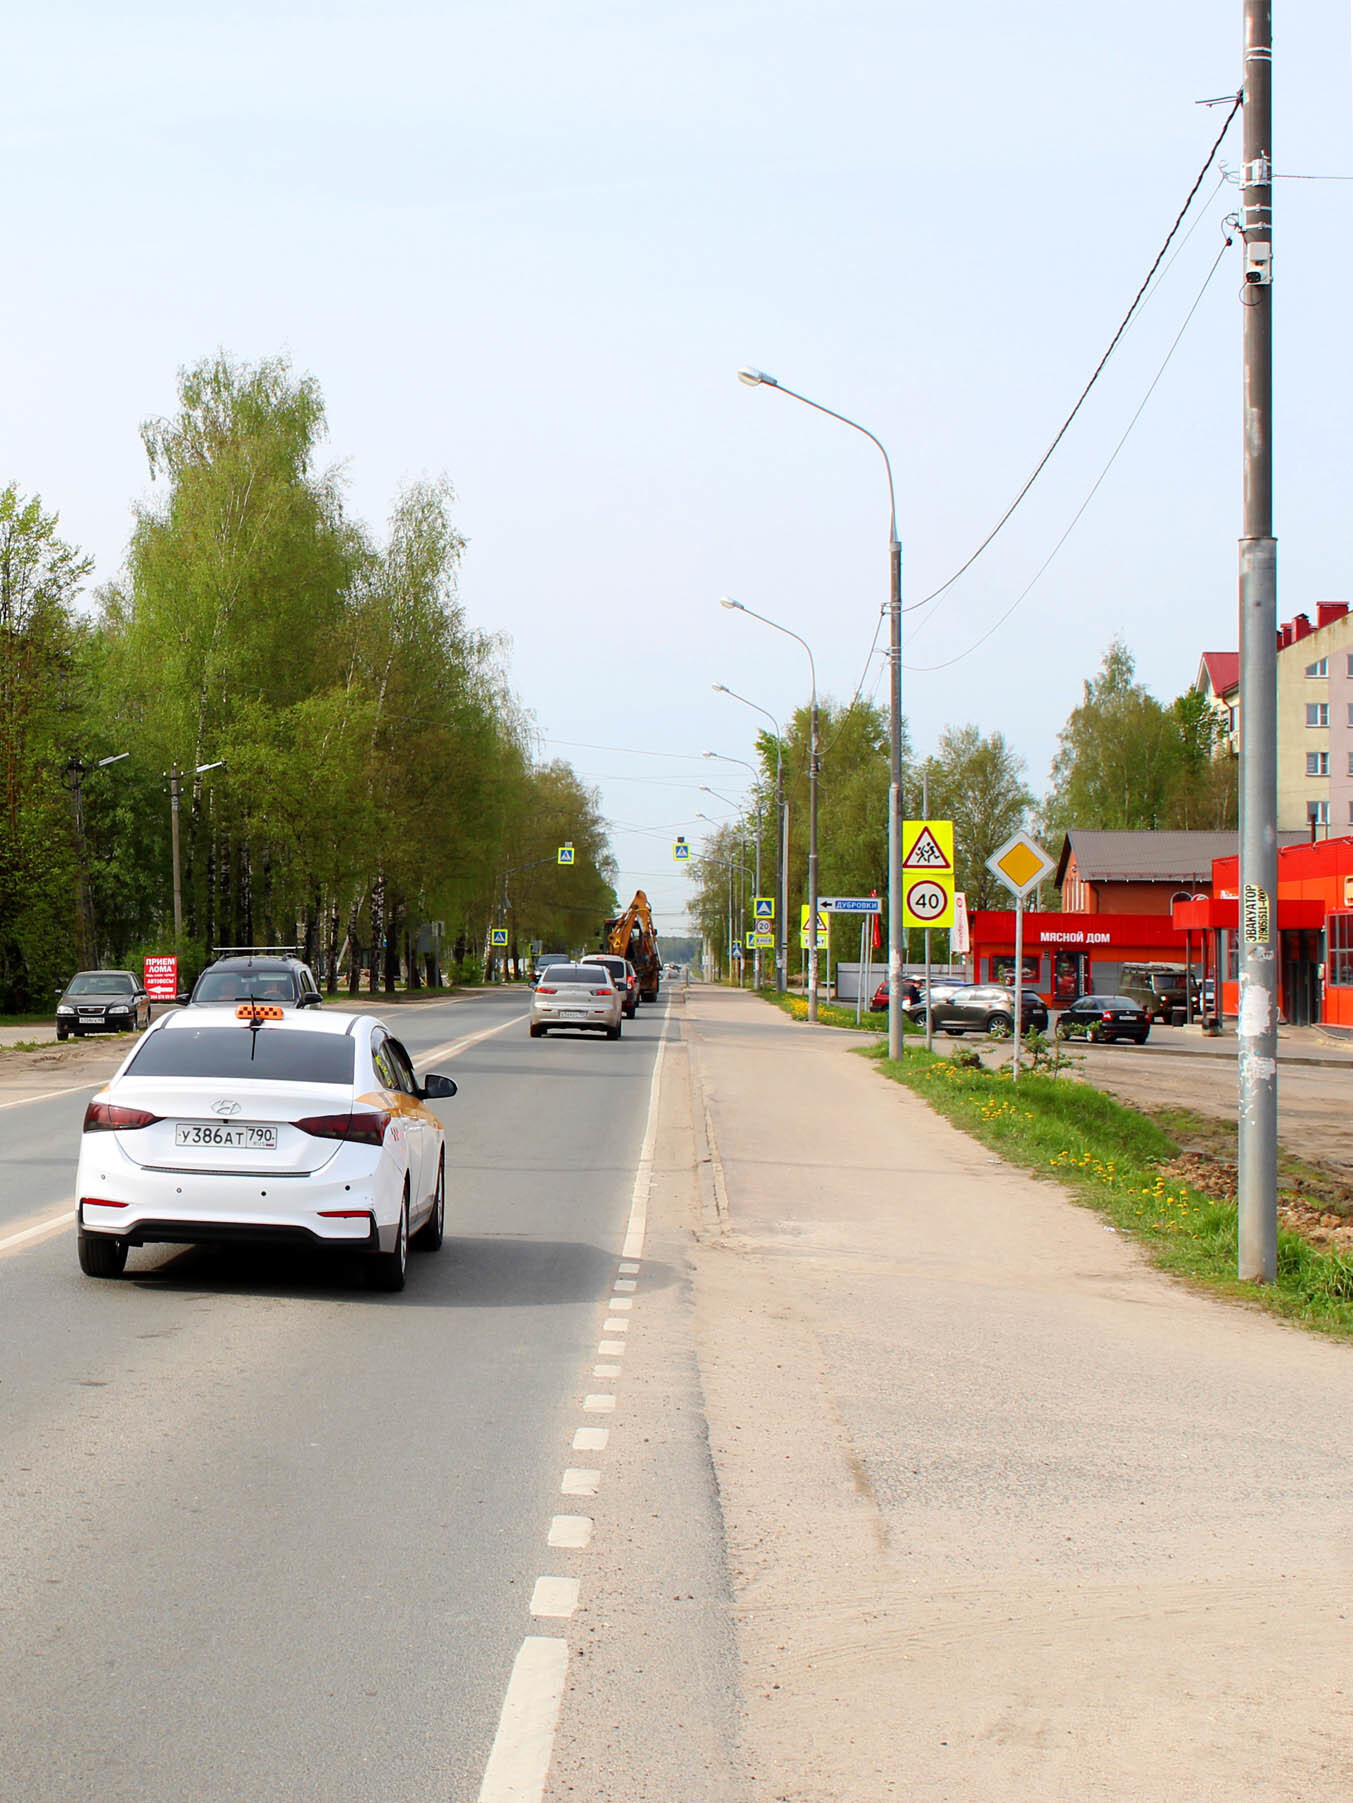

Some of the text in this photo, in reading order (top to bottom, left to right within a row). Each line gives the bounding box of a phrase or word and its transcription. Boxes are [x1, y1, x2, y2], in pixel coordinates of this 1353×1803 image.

[836, 901, 877, 909] ДУБРОВКИ
[915, 893, 939, 909] 40
[1245, 884, 1257, 942] ЭВАКУАТОР
[759, 922, 769, 930] 20
[1040, 931, 1110, 943] МЯСНОЙ ДОМ
[146, 958, 175, 966] ПРИЕМ
[247, 1128, 272, 1141] 790
